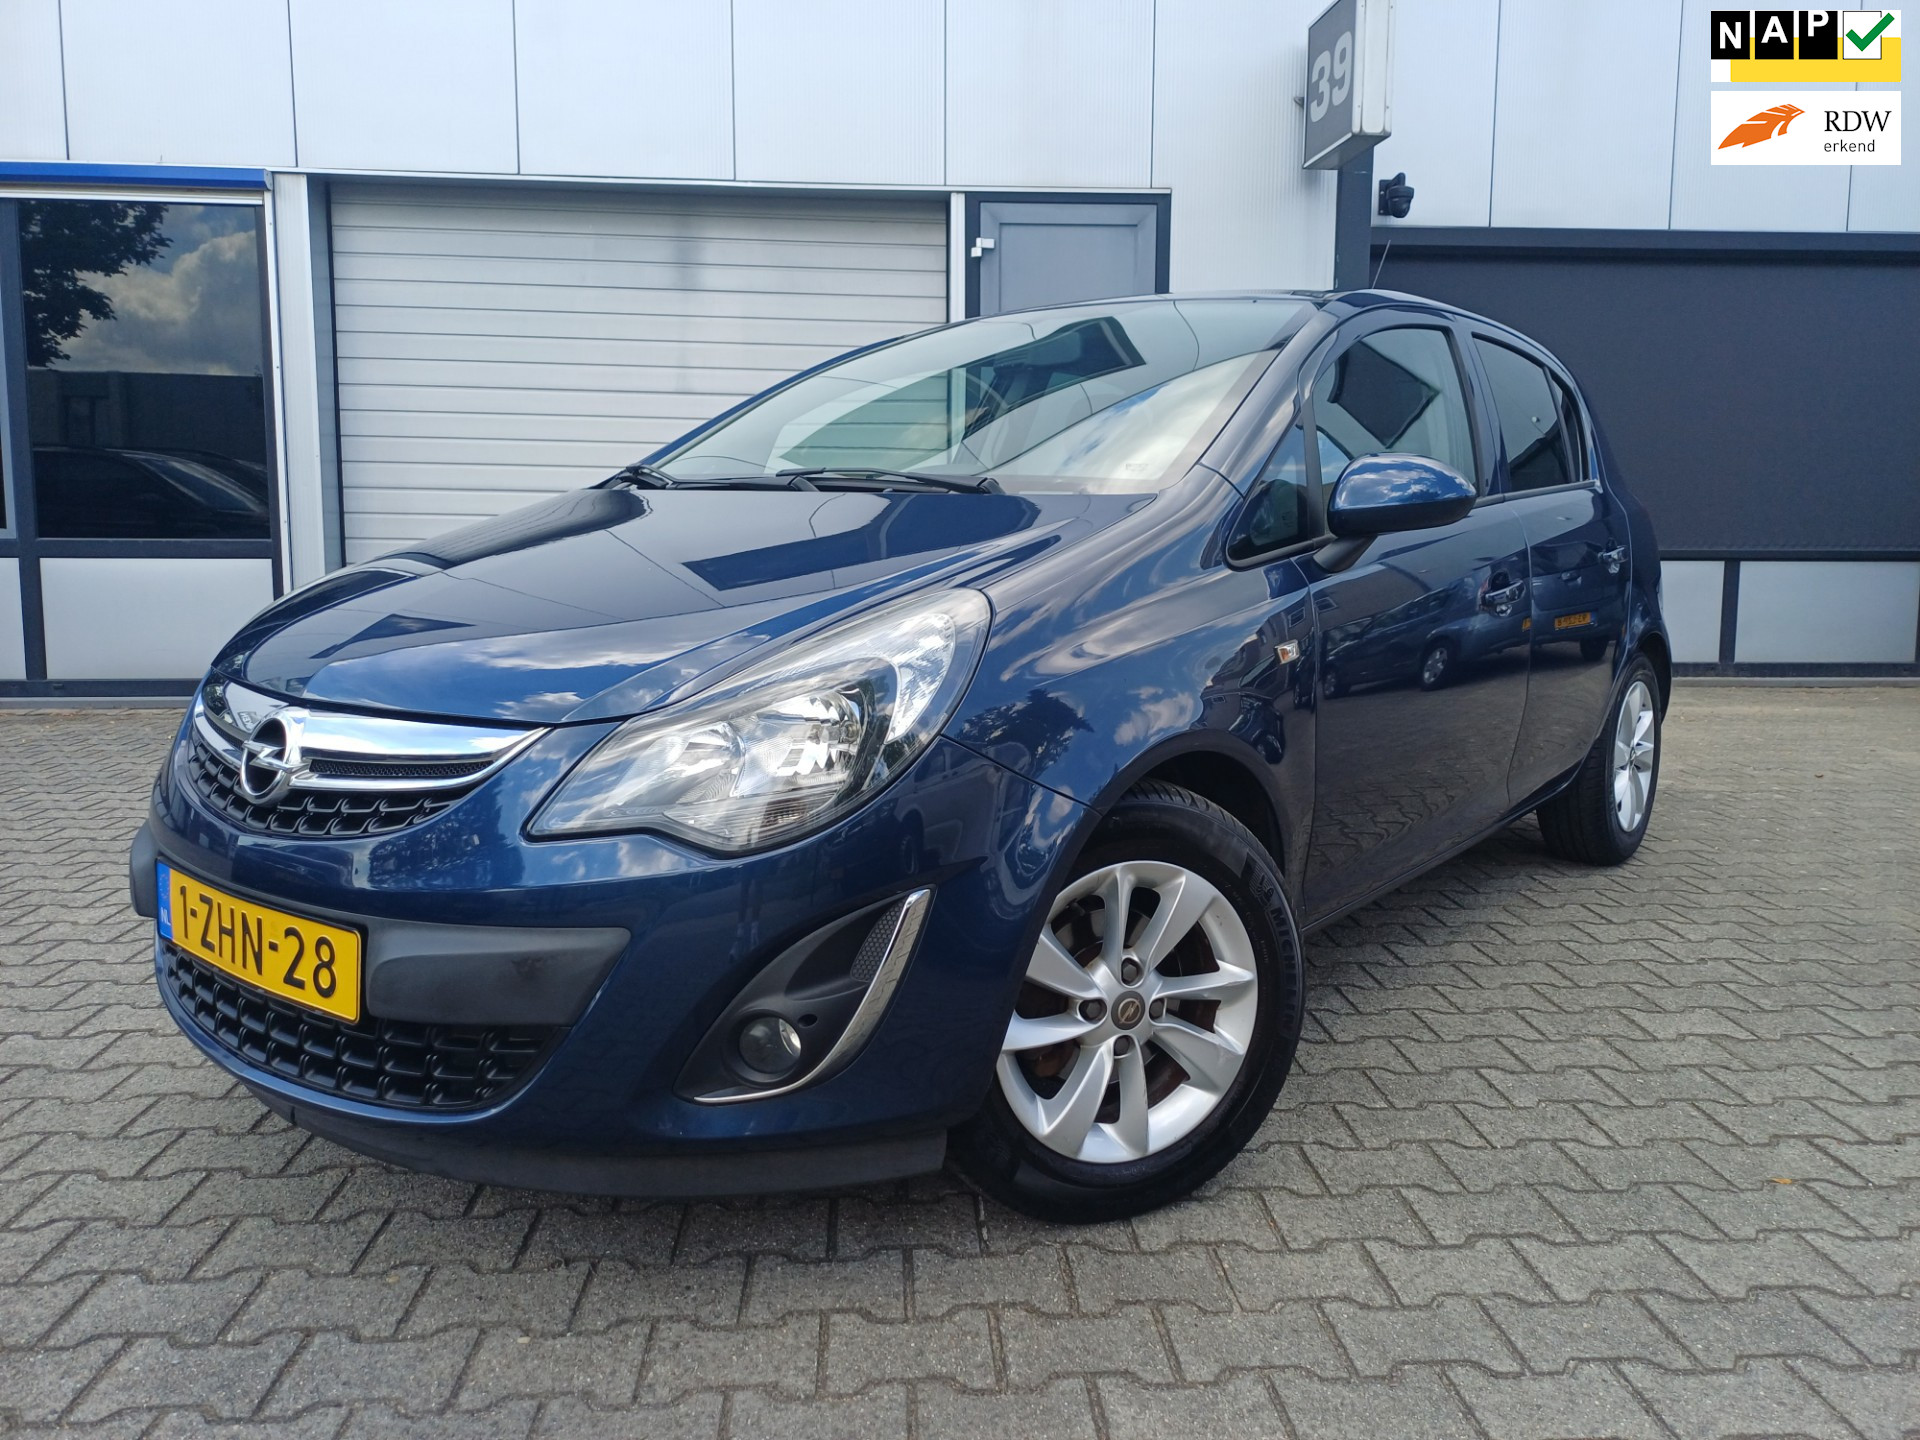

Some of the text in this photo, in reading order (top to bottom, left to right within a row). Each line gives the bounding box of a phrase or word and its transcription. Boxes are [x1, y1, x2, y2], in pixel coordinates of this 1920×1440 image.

[1310, 31, 1352, 122] 39
[160, 907, 172, 926] NL
[180, 885, 337, 998] 1-ZHN-28
